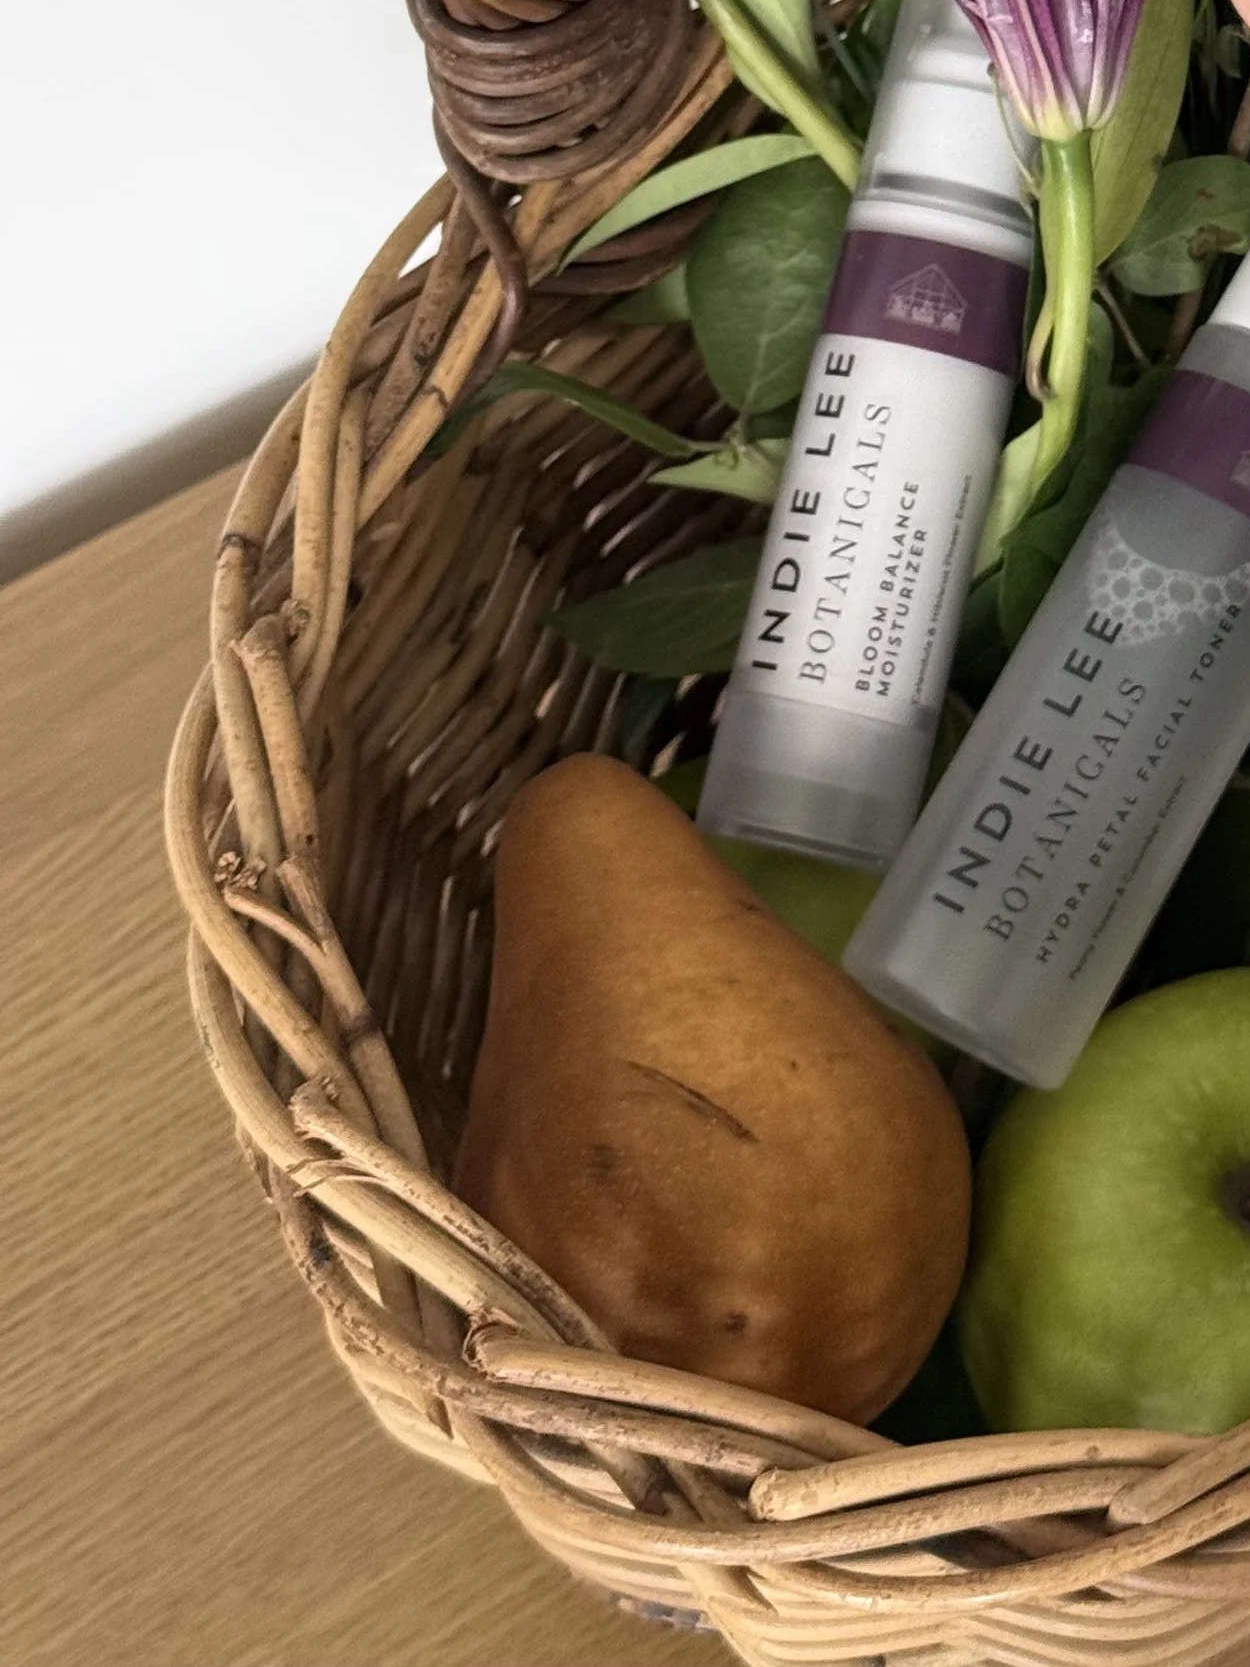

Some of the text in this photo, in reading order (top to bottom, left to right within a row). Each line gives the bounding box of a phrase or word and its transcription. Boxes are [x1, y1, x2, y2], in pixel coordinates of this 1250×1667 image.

[752, 350, 855, 672] INDIE LEE
[799, 403, 892, 683] BOTANICALS
[855, 482, 920, 691] BLOOM BALANCE
[875, 530, 929, 696] MOISTURIZER
[933, 609, 1124, 913] INDIE LEE
[984, 676, 1150, 941] BOTANICALS
[1036, 603, 1244, 964] HYDRA PETAL FACIAL TONER
